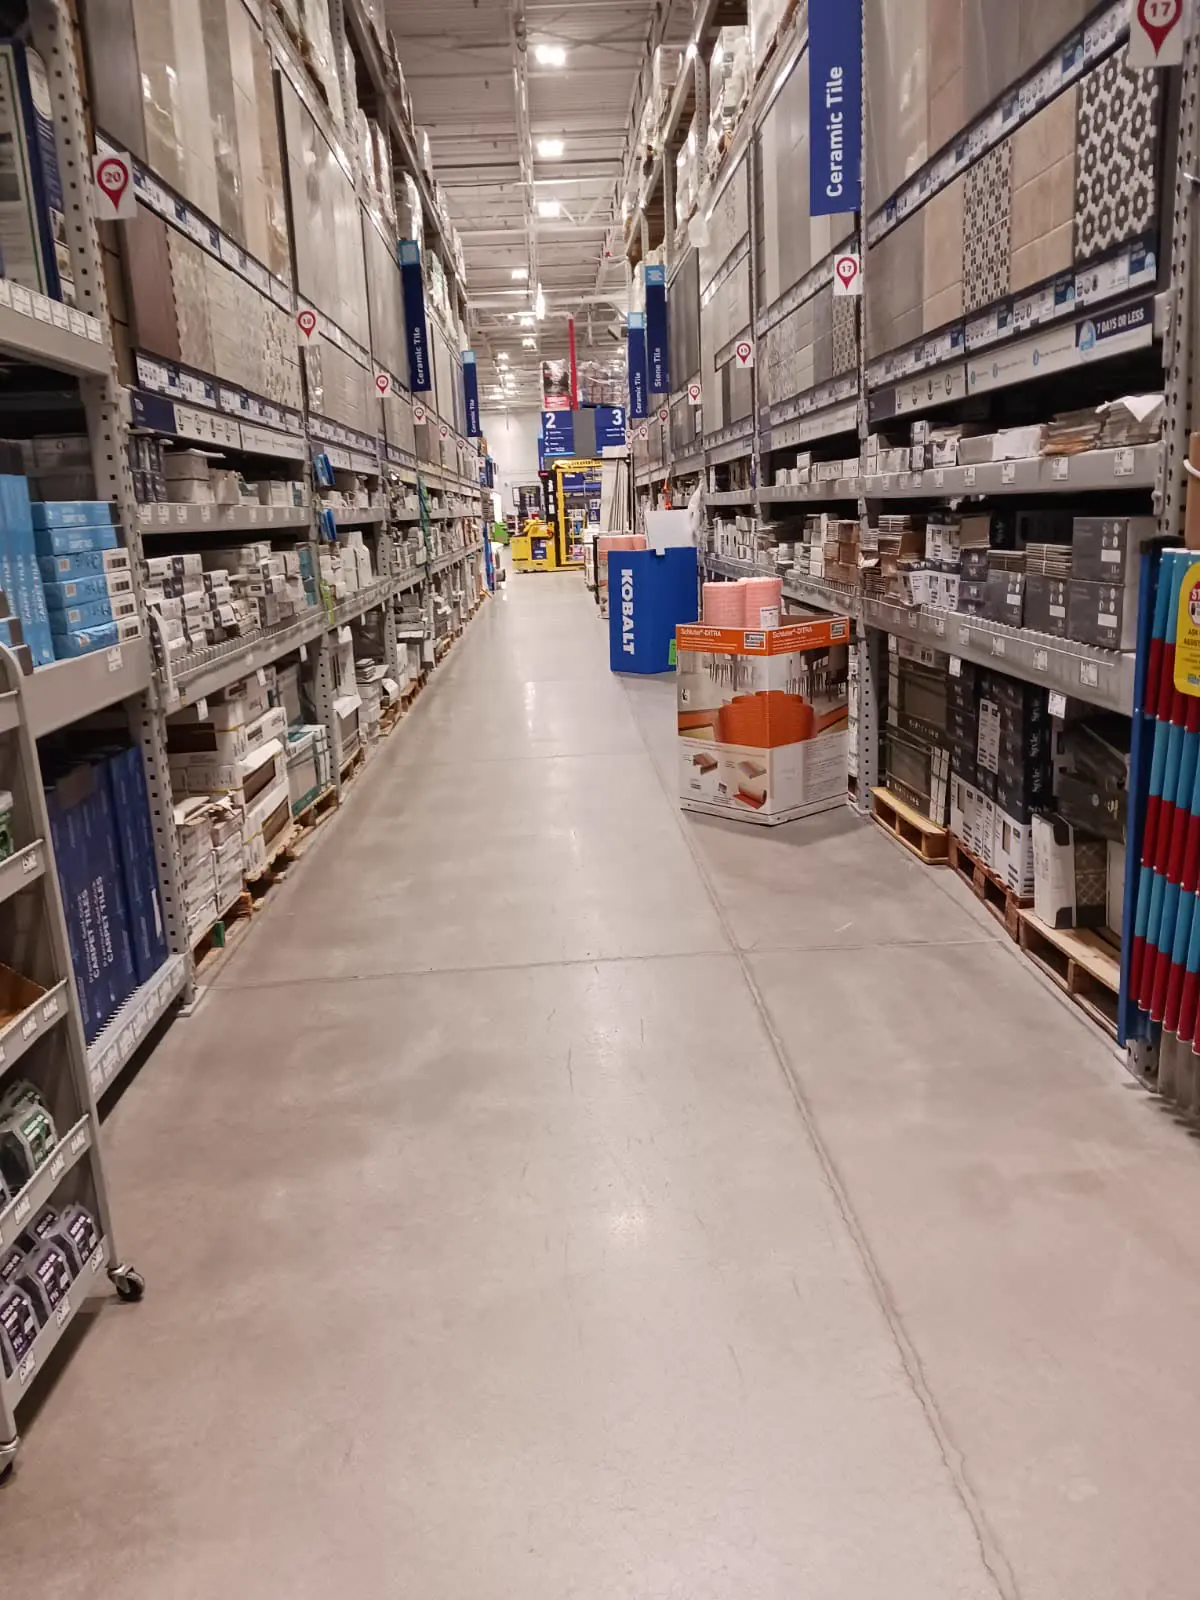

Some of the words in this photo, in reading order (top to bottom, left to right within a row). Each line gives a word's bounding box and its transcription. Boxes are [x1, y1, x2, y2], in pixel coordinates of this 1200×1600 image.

[1151, 1, 1171, 17] 17
[826, 66, 843, 108] Tile
[826, 111, 844, 197] Ceramic
[104, 170, 122, 184] 20
[841, 264, 853, 273] 17
[1096, 322, 1101, 334] 7
[1101, 317, 1118, 333] DAYS
[1117, 314, 1127, 328] OR
[1127, 308, 1144, 324] LESS
[413, 326, 422, 344] Tile
[415, 346, 425, 385] Ceramic
[653, 347, 661, 361] Tile
[654, 362, 662, 388] Stone
[545, 412, 556, 429] 2
[611, 409, 623, 426] 3
[620, 568, 635, 656] KOBALT
[96, 876, 107, 912] TILES
[82, 889, 92, 928] TILES
[102, 915, 114, 963] CARPET
[87, 930, 100, 979] CARPET
